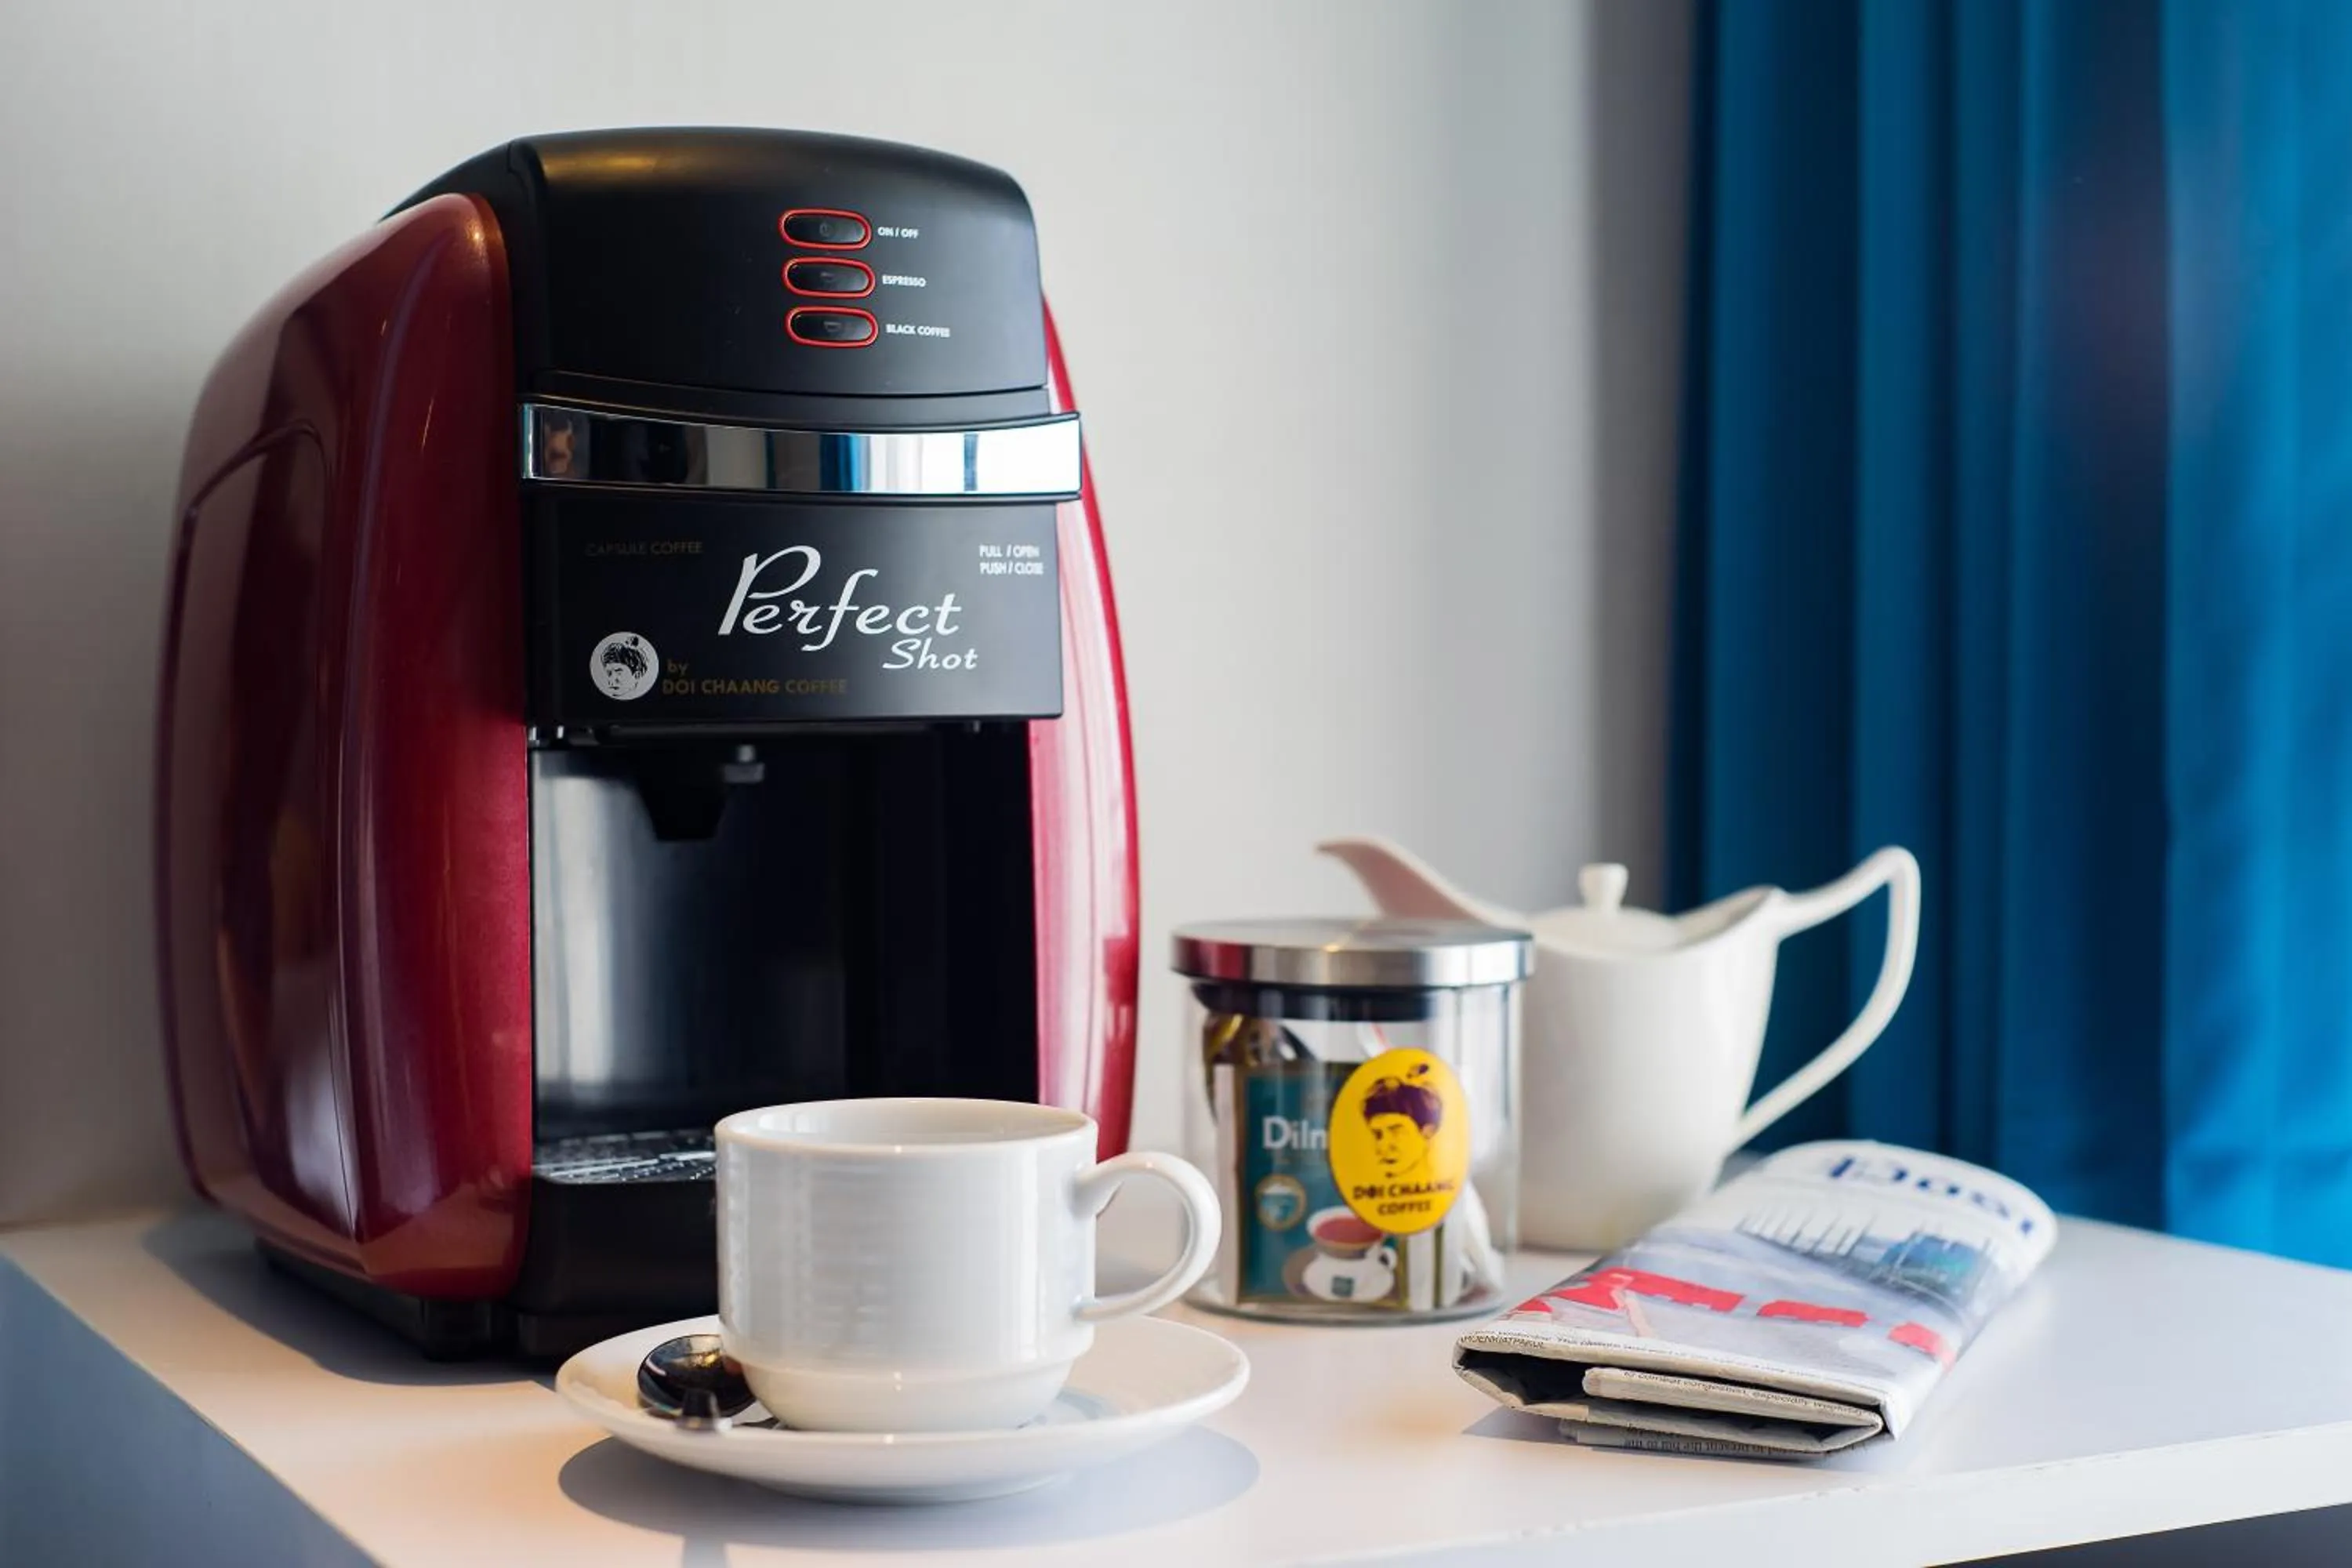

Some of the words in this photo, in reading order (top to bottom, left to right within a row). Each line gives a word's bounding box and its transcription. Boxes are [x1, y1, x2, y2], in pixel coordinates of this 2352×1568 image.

[877, 226, 894, 237] ON
[901, 227, 919, 239] OFF
[881, 274, 927, 288] ESPRESSO
[886, 324, 916, 335] BLACK
[917, 325, 951, 338] COFFEE
[651, 541, 703, 555] COFFEE
[978, 544, 1003, 558] PULL
[1012, 545, 1040, 558] OPEN
[979, 561, 1007, 575] PUSH
[1014, 561, 1044, 575] CLOSE
[717, 545, 962, 652] Perfect
[881, 638, 978, 670] Shot
[666, 658, 690, 676] by
[661, 680, 695, 695] DOI
[701, 679, 780, 695] CHAANG
[784, 679, 848, 695] COFFEE
[1352, 1185, 1385, 1200] DOI
